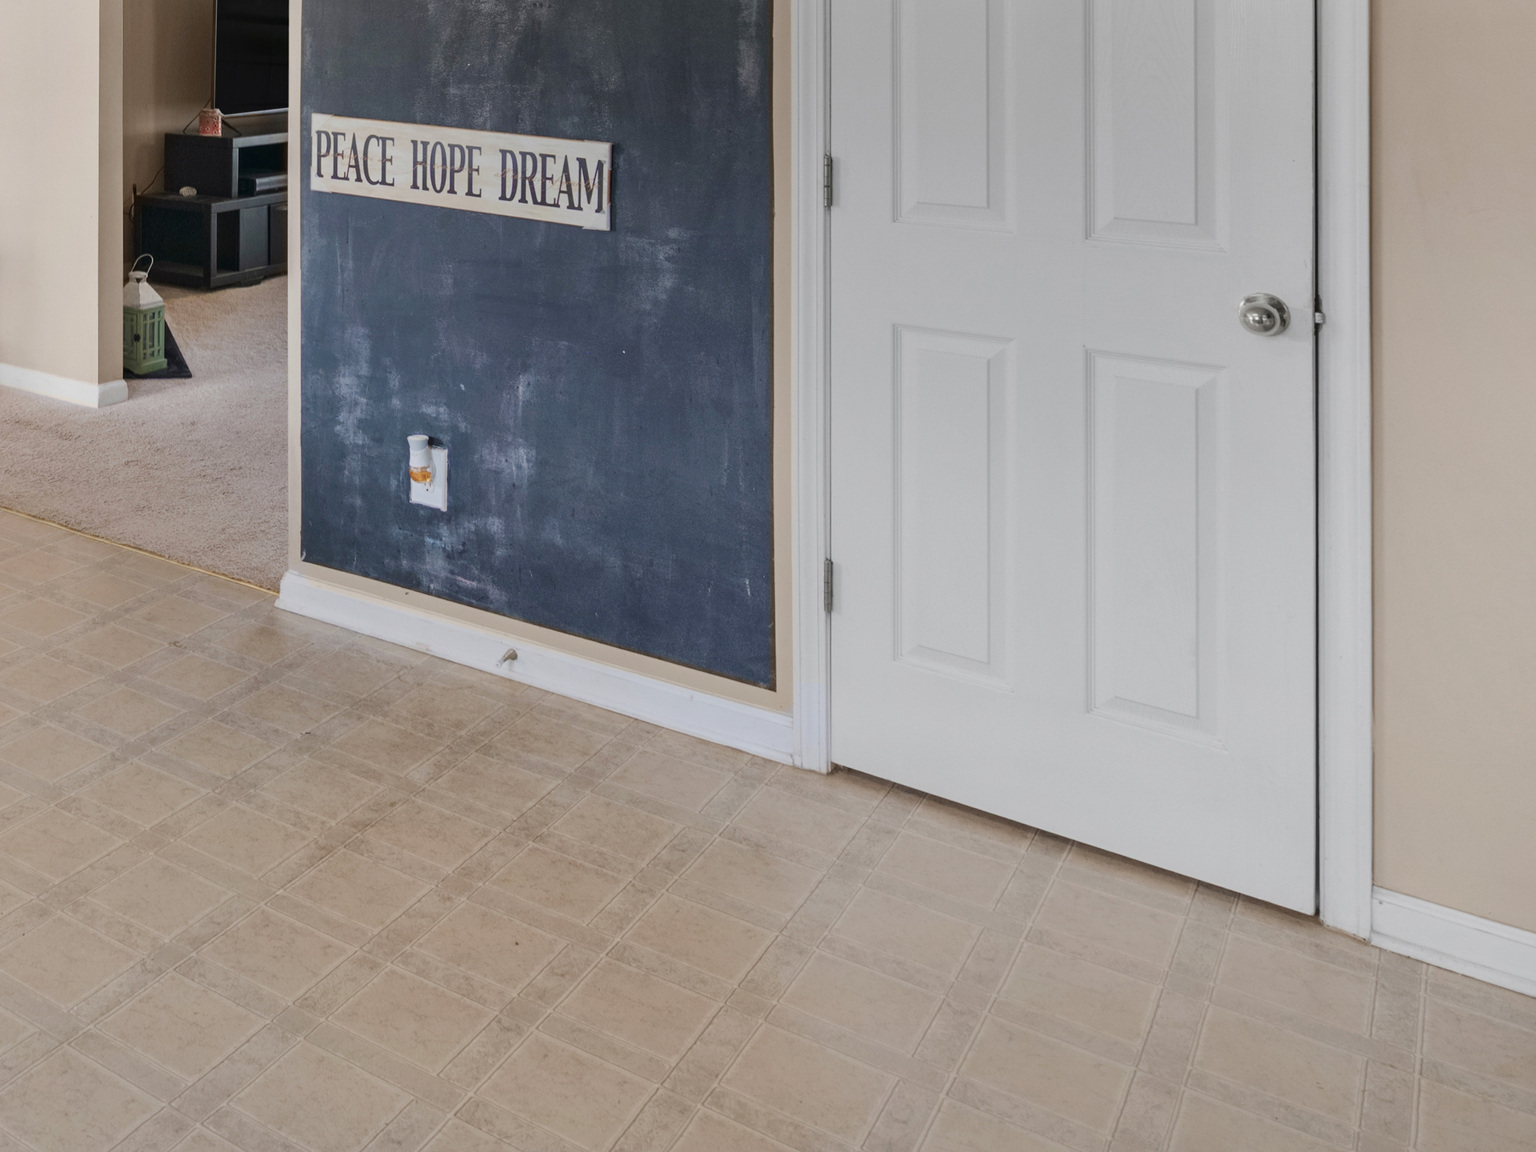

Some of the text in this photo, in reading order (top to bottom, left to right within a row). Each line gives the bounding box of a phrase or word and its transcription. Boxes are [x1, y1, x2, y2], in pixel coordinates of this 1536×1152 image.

[315, 130, 395, 187] PEACE
[410, 139, 482, 197] HOPE
[498, 148, 606, 214] DREAM
